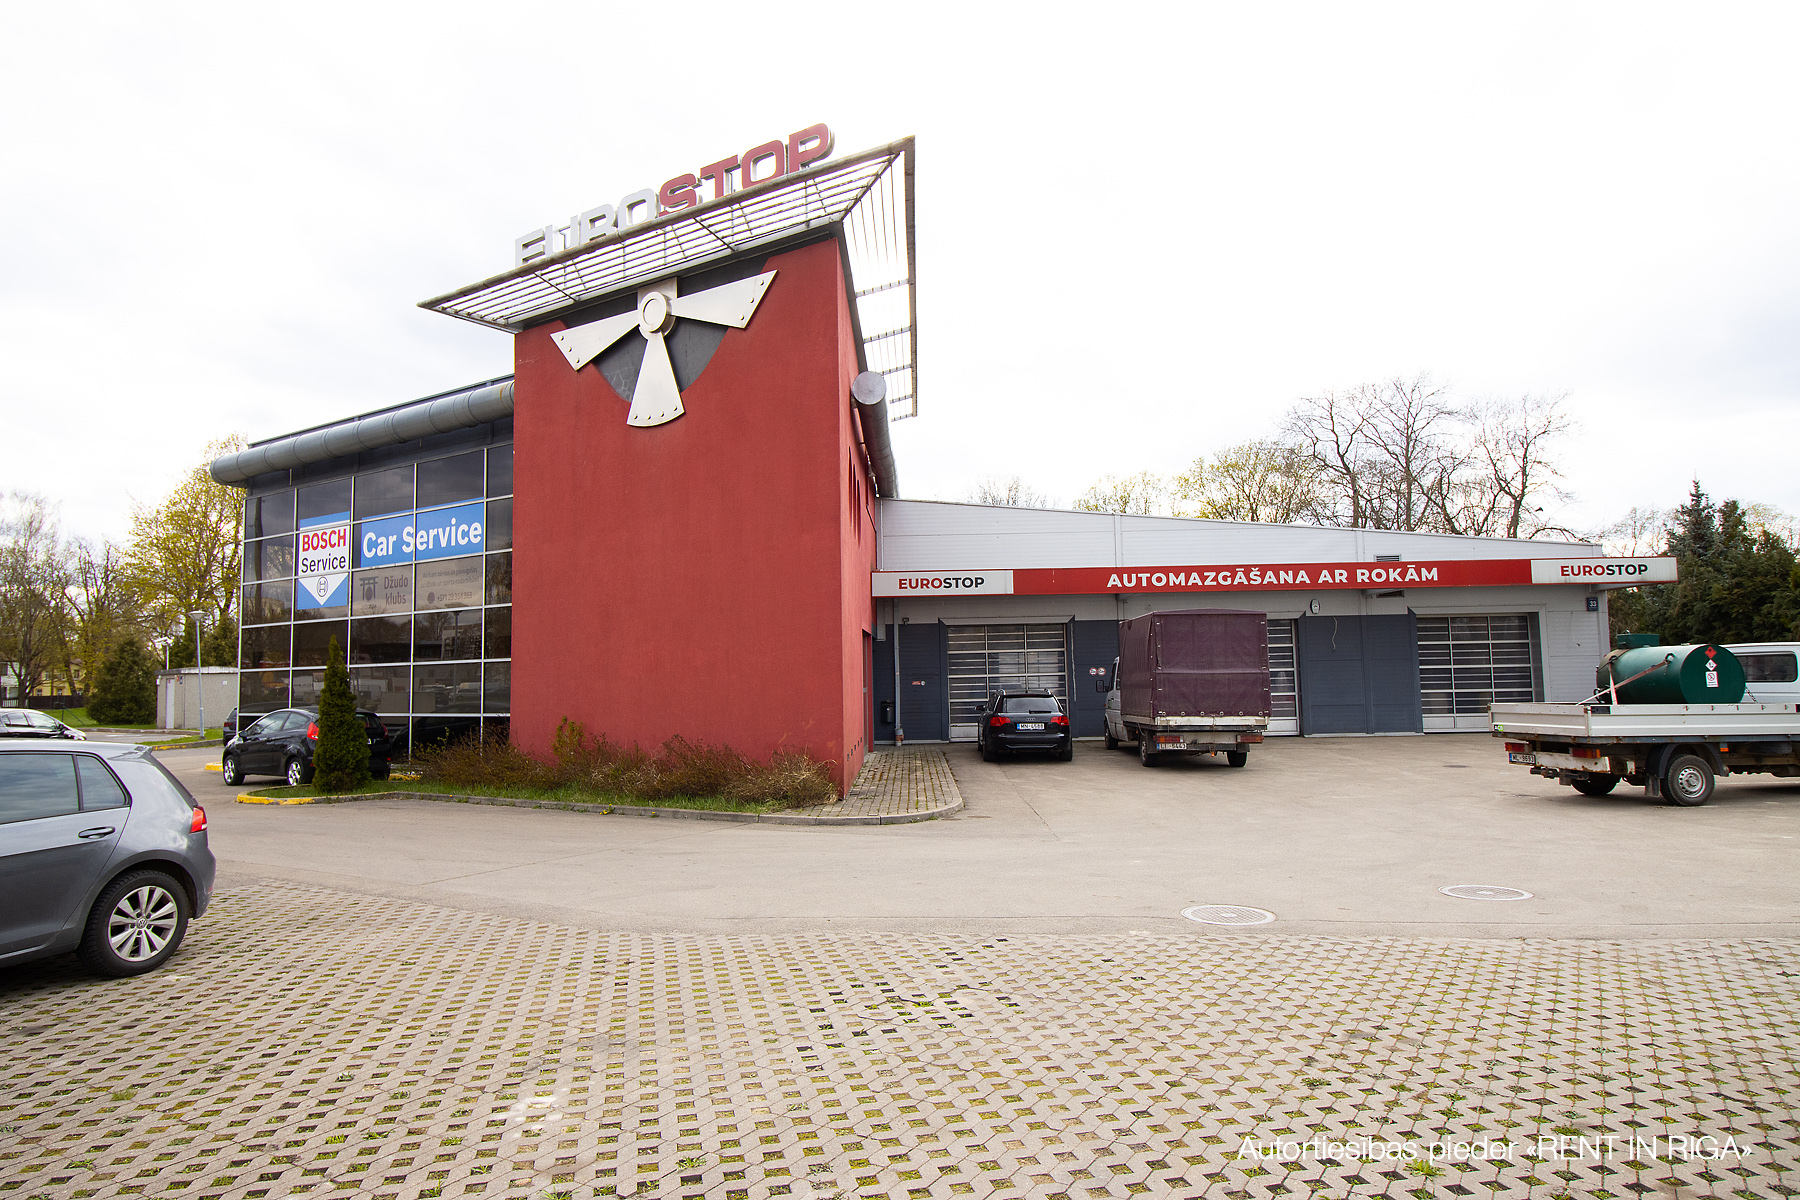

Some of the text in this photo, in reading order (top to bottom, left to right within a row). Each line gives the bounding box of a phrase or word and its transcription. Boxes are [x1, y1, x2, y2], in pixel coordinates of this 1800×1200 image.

[515, 122, 834, 269] EUROSTOP
[302, 528, 347, 552] BOSCH
[363, 517, 482, 558] Car Service
[301, 553, 347, 573] Service
[1560, 564, 1648, 576] EUROSTOP
[384, 574, 409, 589] Džudo
[898, 577, 985, 589] EUROSTOP
[1106, 565, 1438, 588] AUTOMAZGĀŠANA AR ROKĀM
[385, 592, 407, 606] klubs
